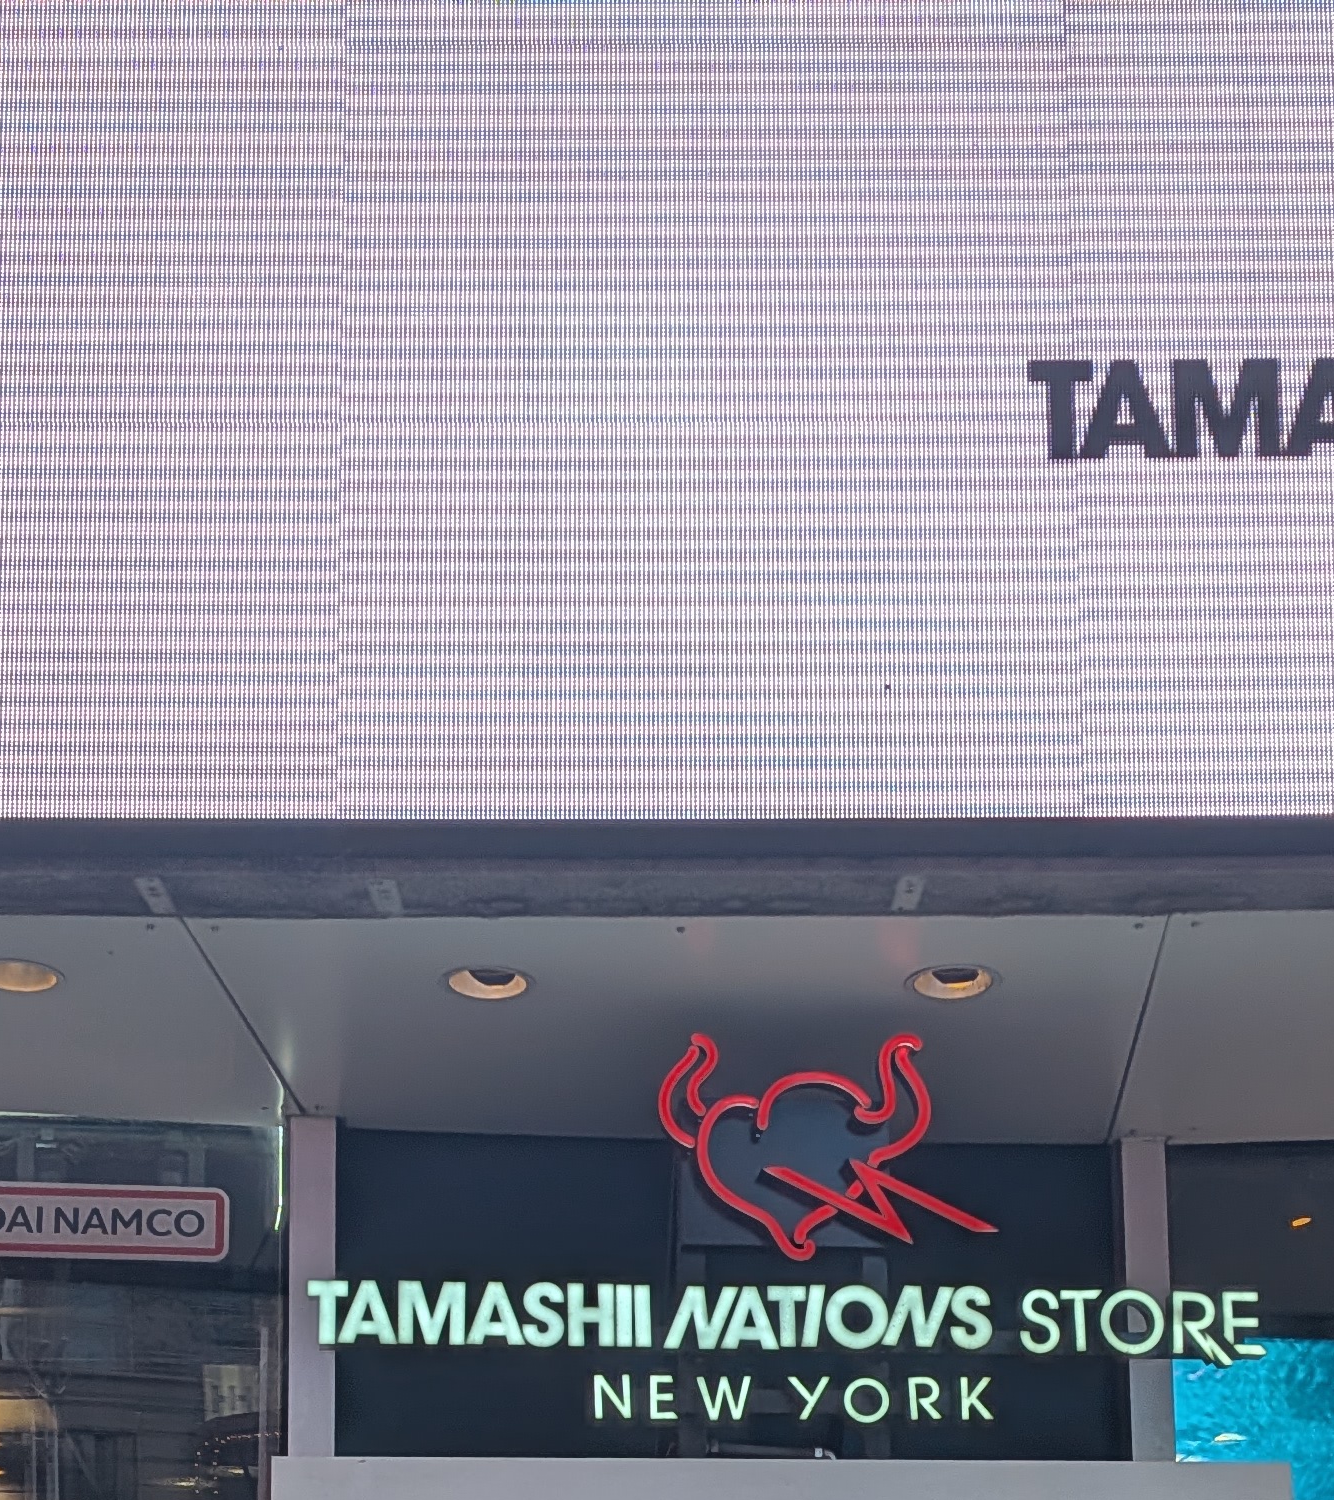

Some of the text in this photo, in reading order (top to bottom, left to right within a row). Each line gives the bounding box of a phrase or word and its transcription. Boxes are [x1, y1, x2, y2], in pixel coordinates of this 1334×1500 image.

[53, 1206, 206, 1239] NAMCO
[307, 1279, 1266, 1367] TAMASHII NATIONS STORE
[593, 1373, 996, 1423] NEW YORK
